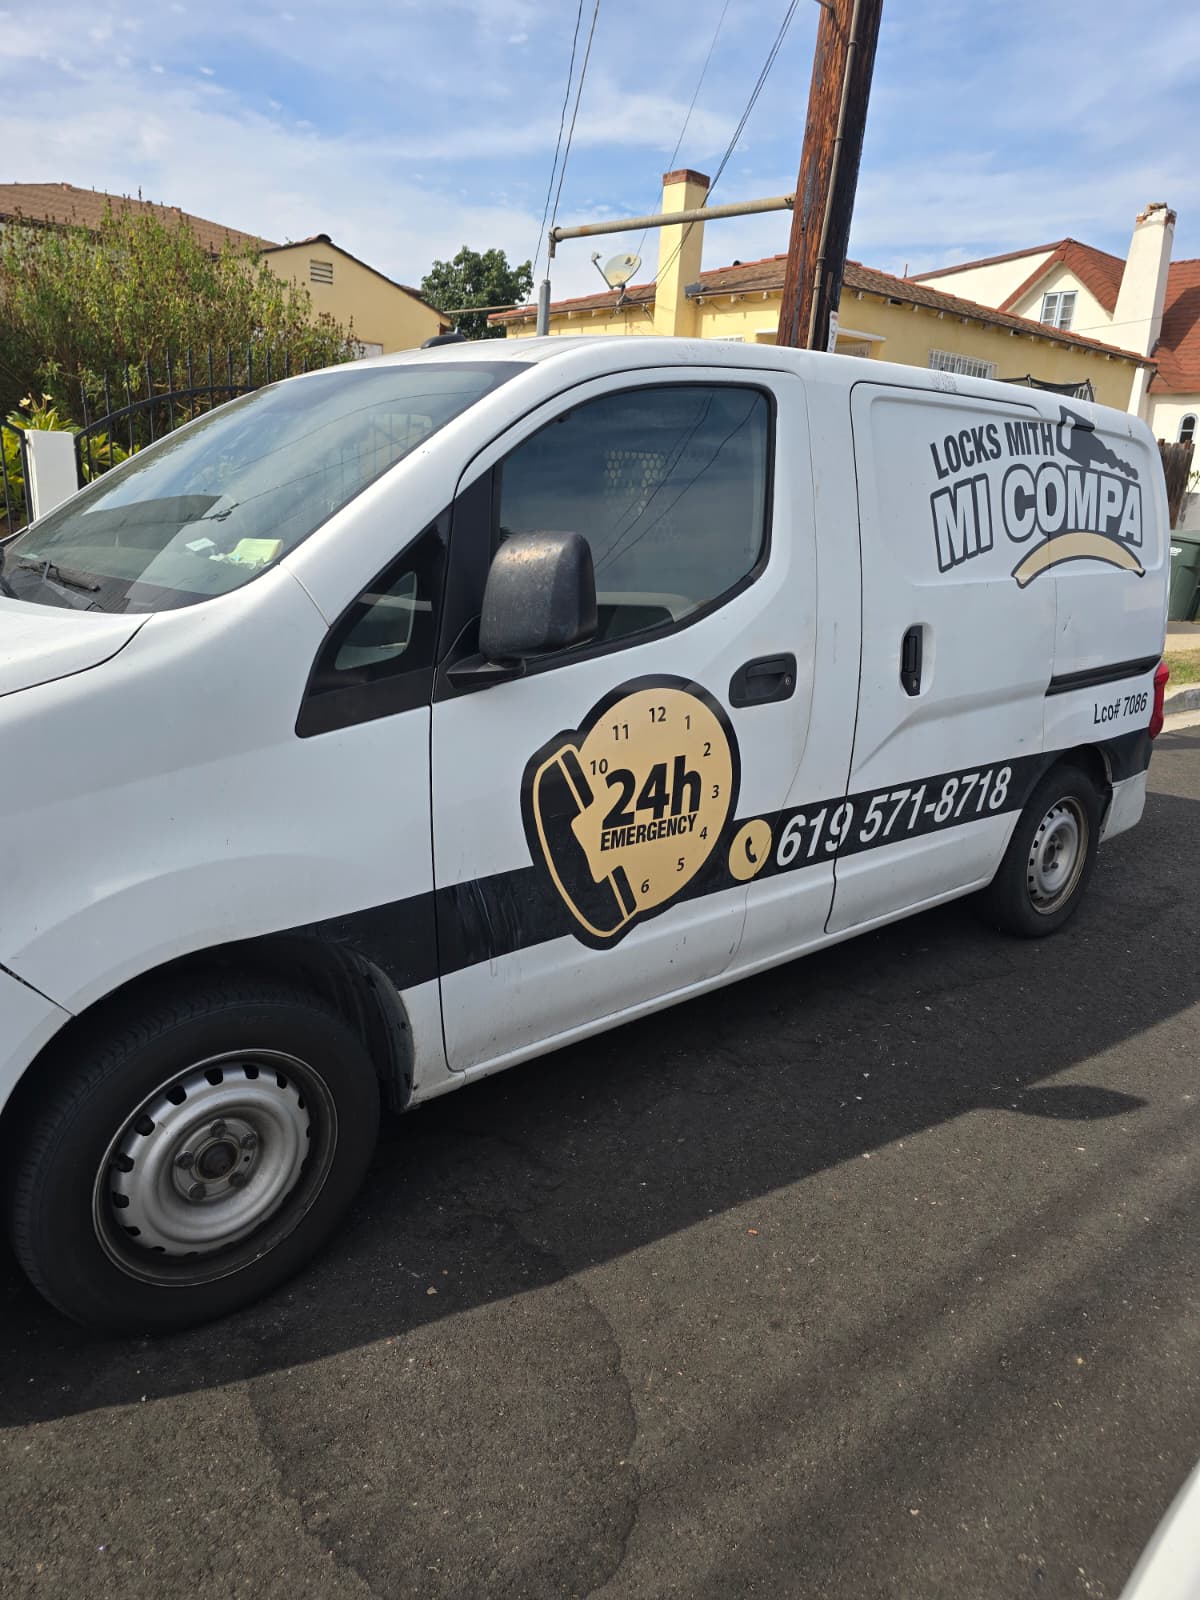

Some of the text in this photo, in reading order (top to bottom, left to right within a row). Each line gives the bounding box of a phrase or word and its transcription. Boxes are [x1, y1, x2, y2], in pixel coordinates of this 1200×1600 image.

[930, 422, 1055, 480] LOCKS MITH
[930, 462, 1143, 573] MI COMPA
[1123, 692, 1148, 717] 7086
[649, 706, 667, 723] 12
[684, 715, 691, 730] 1
[612, 724, 629, 740] 11
[703, 742, 711, 757] 2
[590, 759, 608, 775] 10
[602, 755, 702, 830] 24h
[712, 784, 720, 798] 3
[776, 767, 1012, 867] 619 571-8718
[600, 813, 698, 851] EMERGENCY
[699, 826, 708, 840] 4
[676, 857, 685, 872] 5
[640, 878, 650, 893] 6
